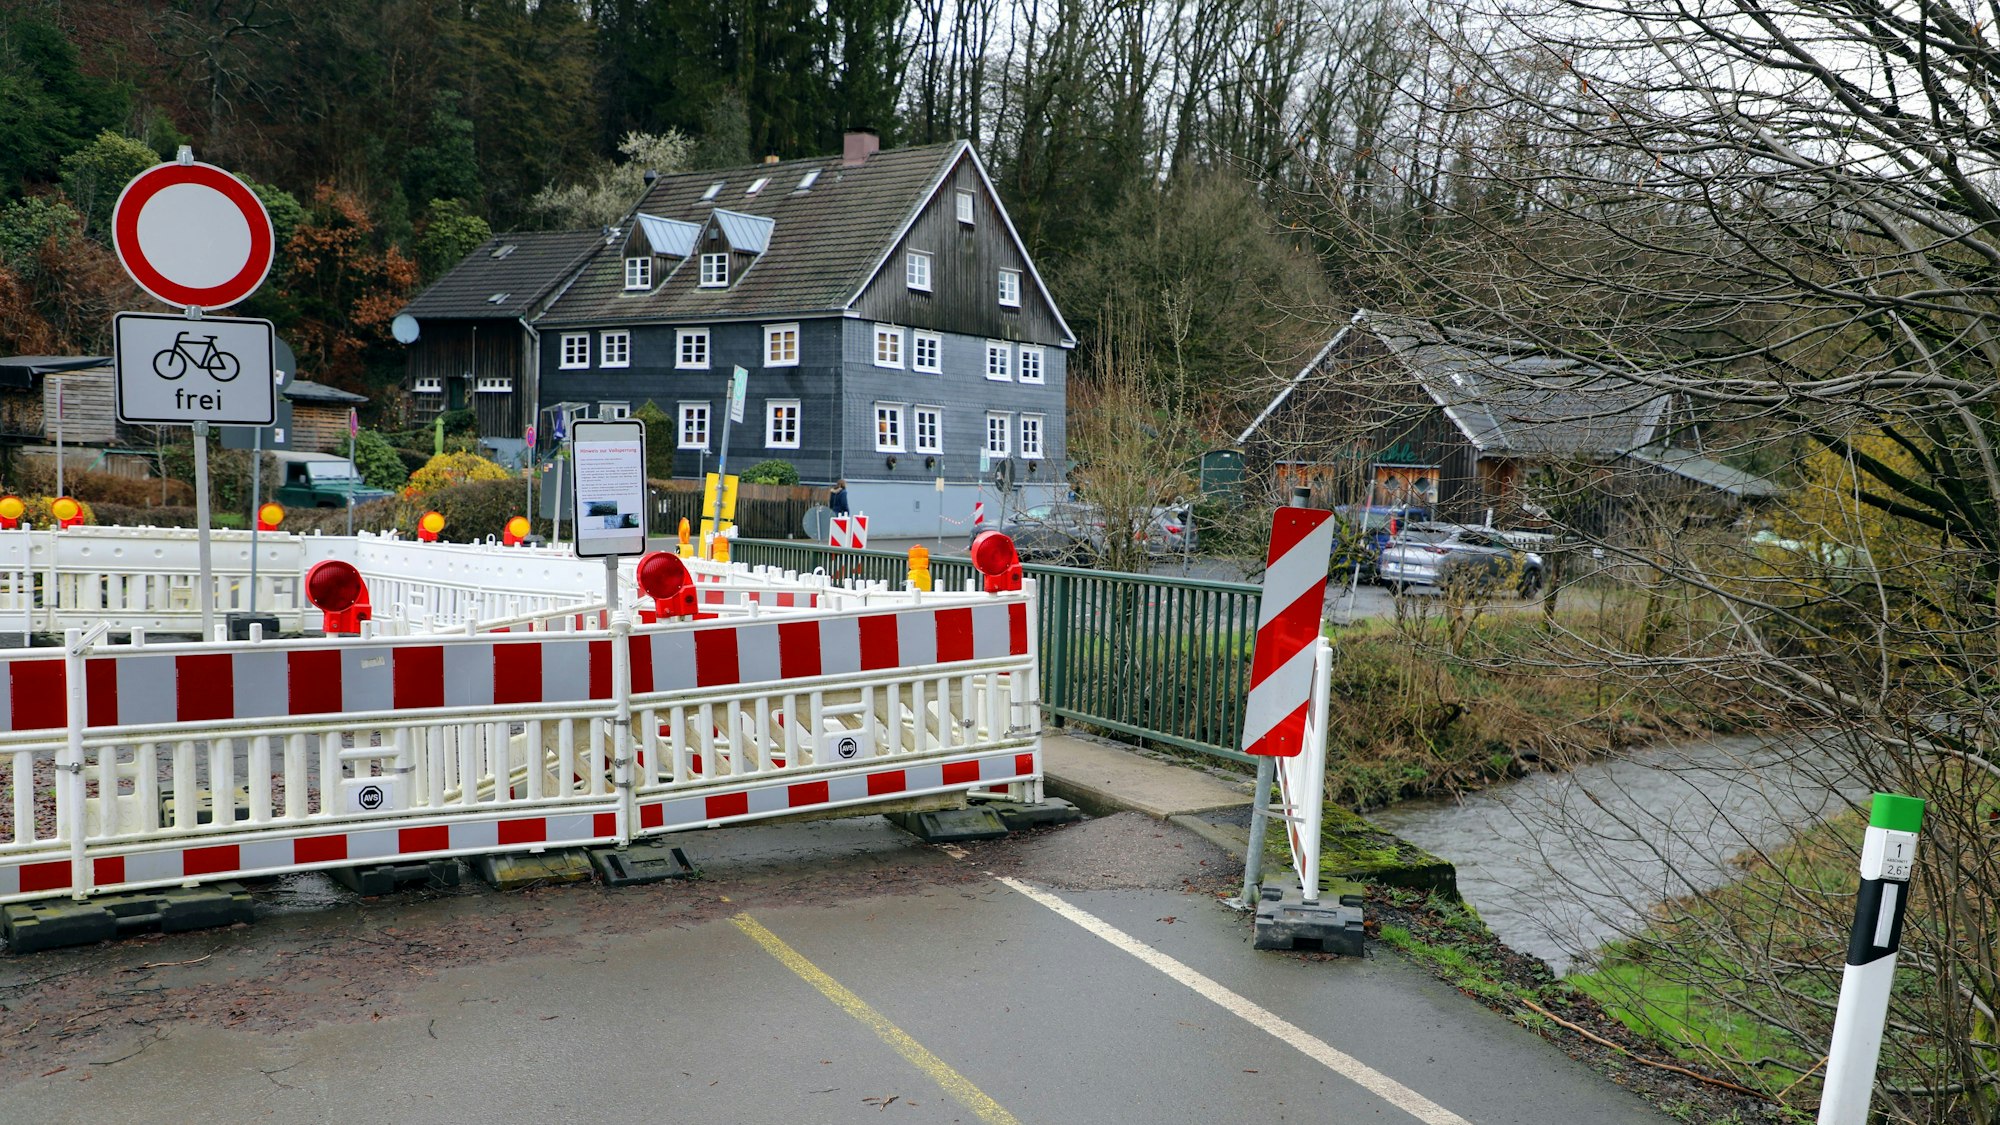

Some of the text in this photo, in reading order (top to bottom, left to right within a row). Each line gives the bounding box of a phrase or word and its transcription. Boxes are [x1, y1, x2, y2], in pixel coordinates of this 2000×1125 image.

[175, 388, 222, 411] frei
[842, 744, 855, 752] AVS
[363, 793, 379, 802] AVS
[1897, 843, 1902, 858] 1
